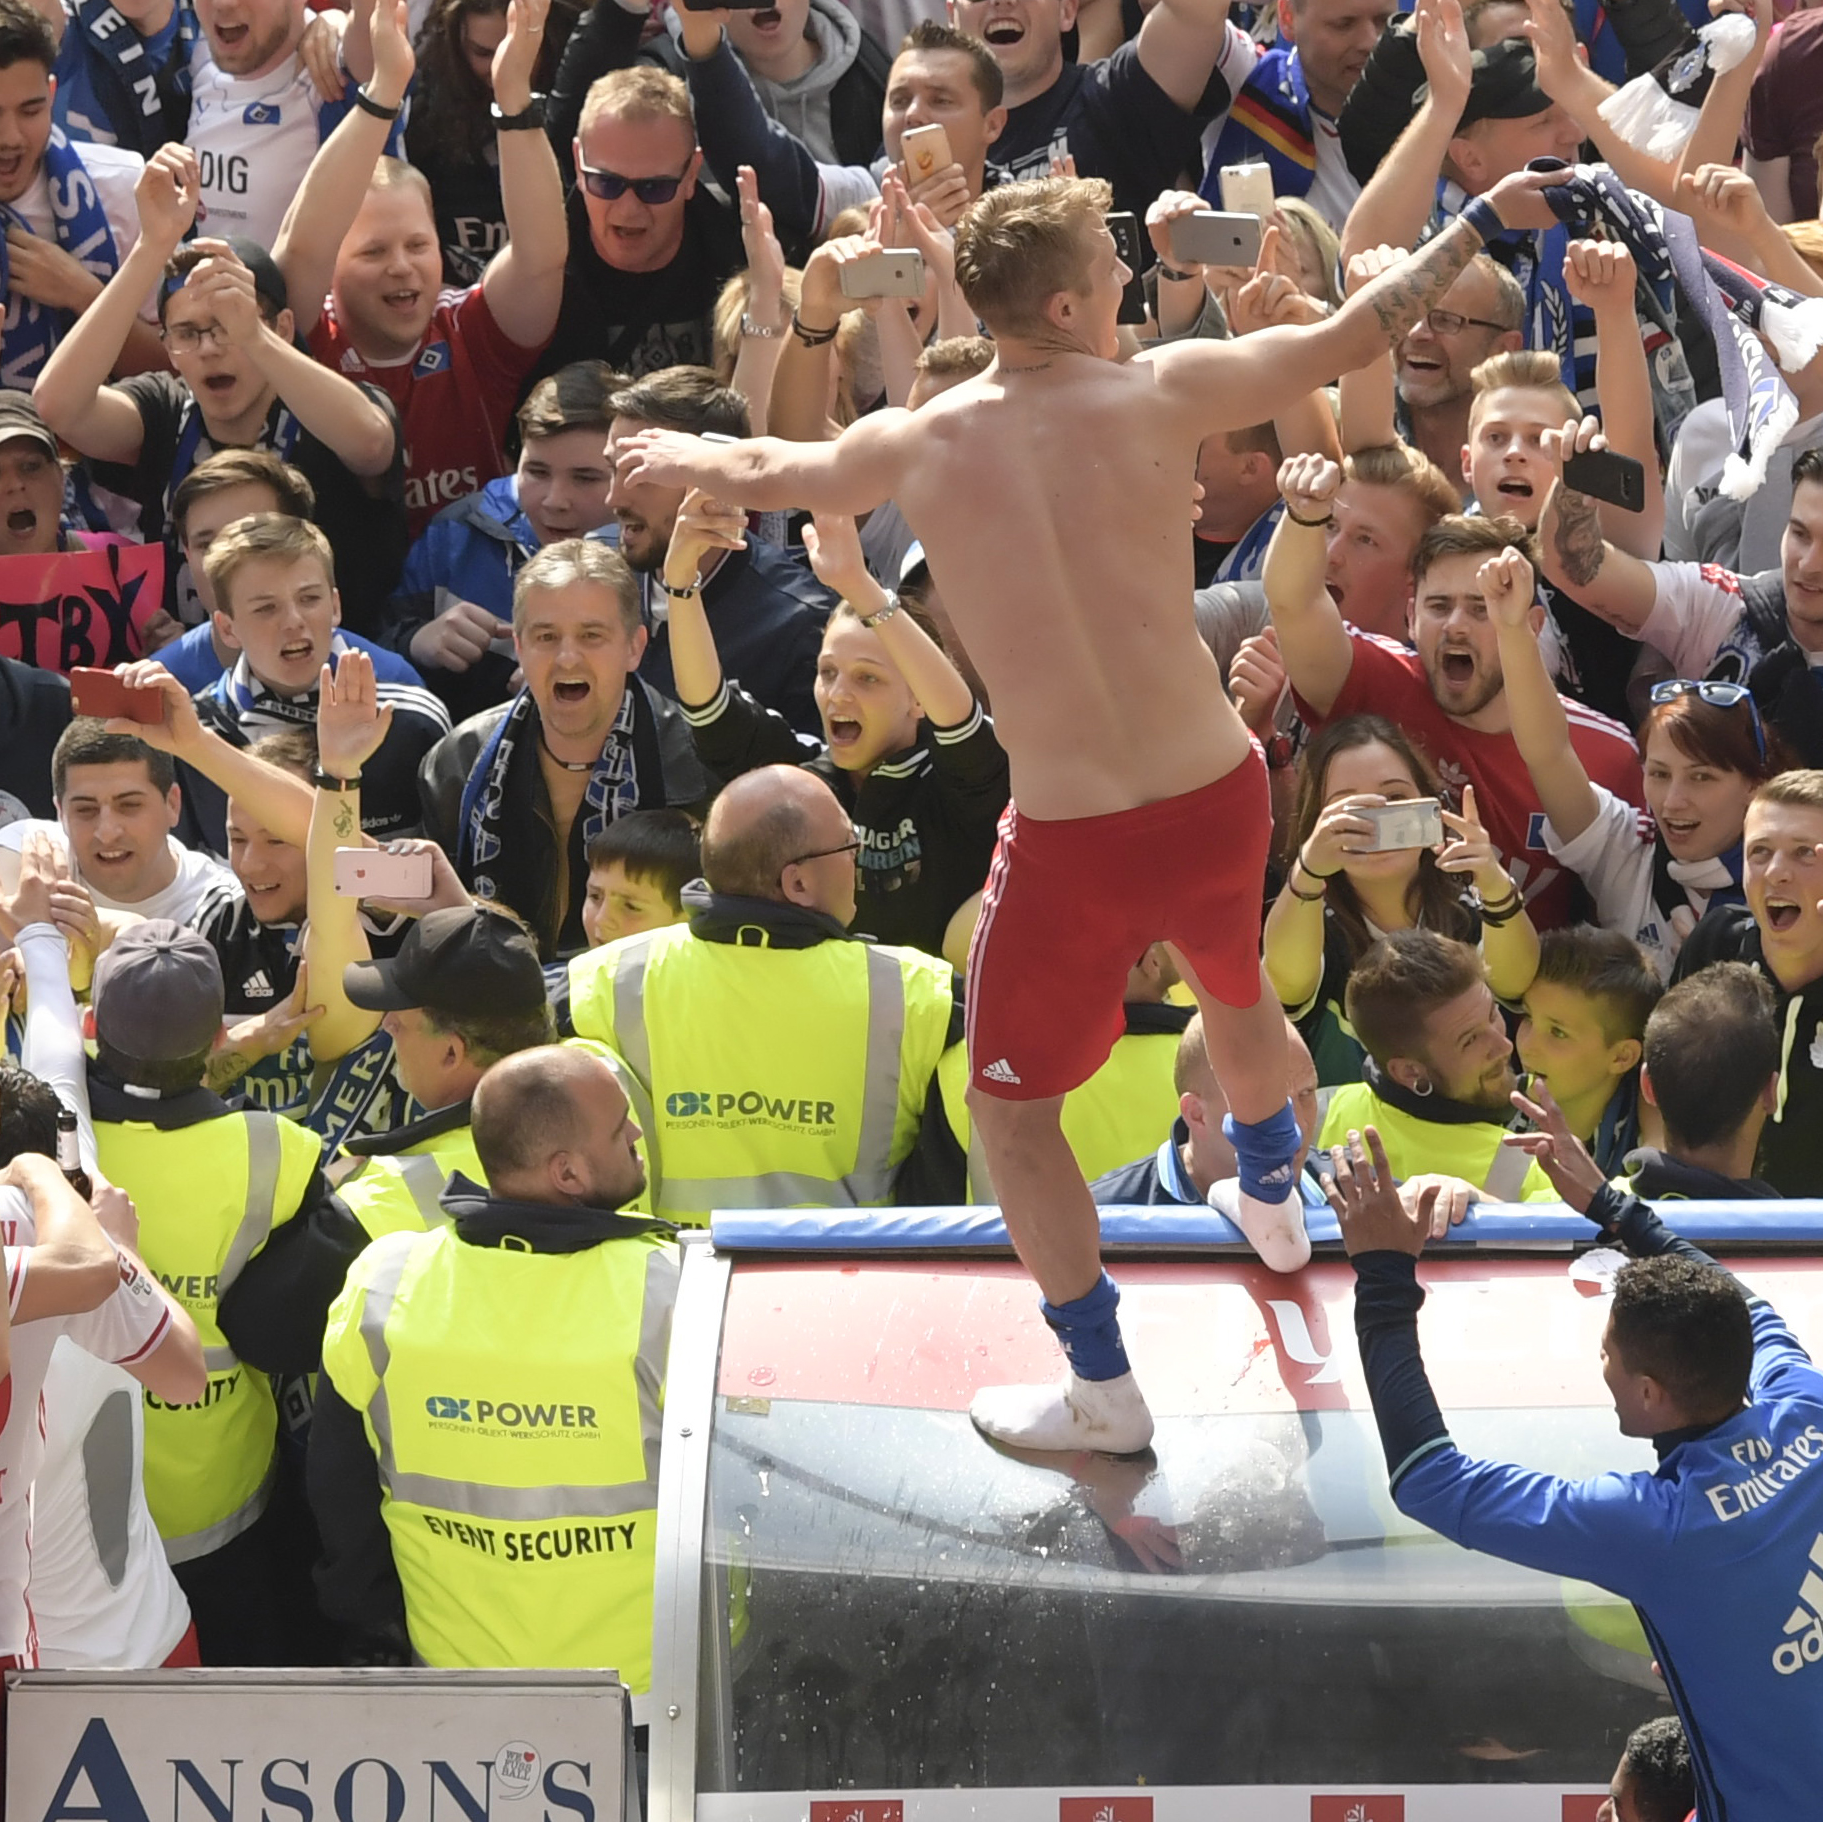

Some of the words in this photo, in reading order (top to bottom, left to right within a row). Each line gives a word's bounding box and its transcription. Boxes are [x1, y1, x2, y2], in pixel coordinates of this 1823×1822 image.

[405, 465, 480, 510] ates
[981, 1068, 1022, 1086] adidas
[716, 1091, 835, 1125] POWER
[477, 1401, 599, 1430] POWER
[1730, 1429, 1773, 1467] Fly
[426, 1514, 497, 1558] EVENT
[503, 1520, 638, 1563] SECURITY
